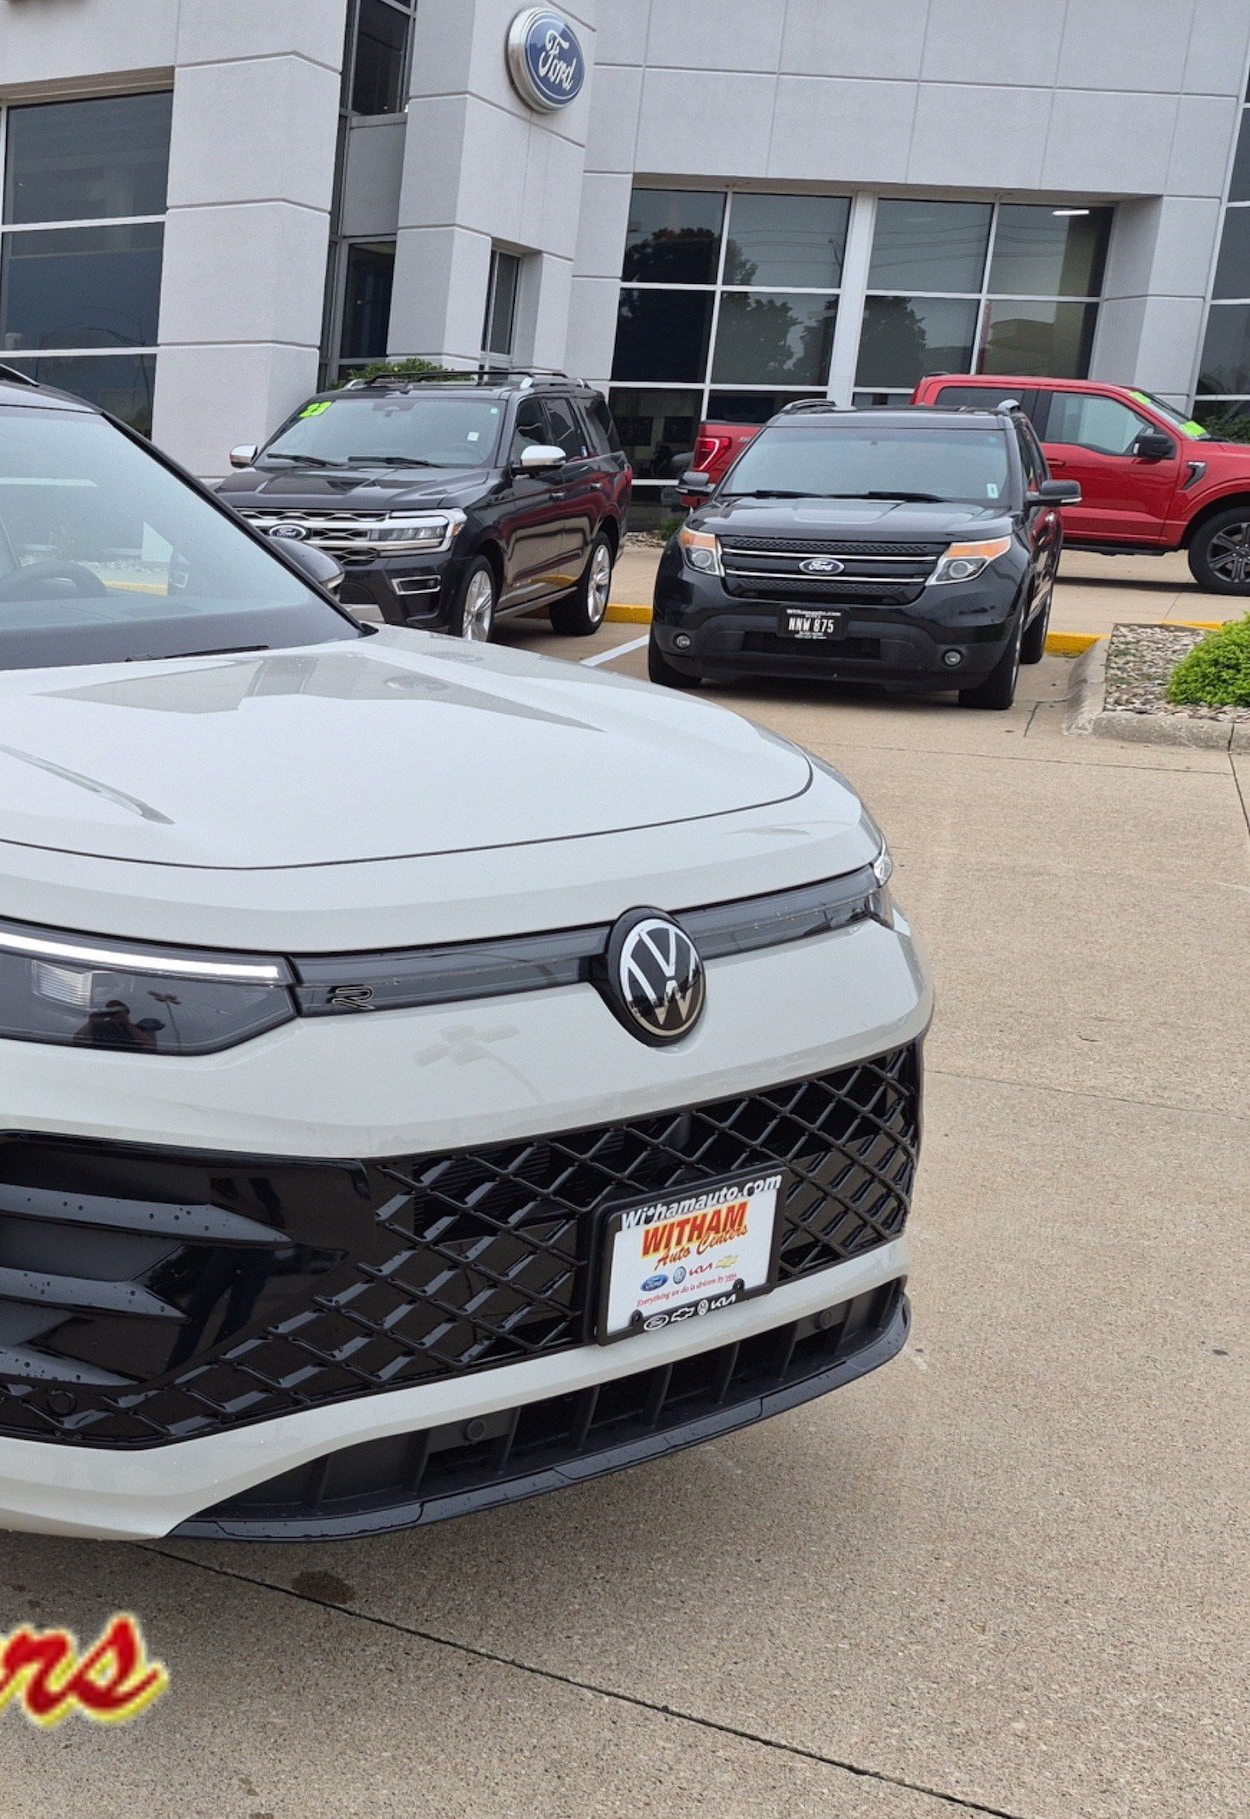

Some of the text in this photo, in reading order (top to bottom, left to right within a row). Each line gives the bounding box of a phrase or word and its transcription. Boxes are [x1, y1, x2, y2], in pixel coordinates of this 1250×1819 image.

[538, 29, 576, 91] Ford
[808, 560, 834, 571] Ford
[813, 619, 835, 633] 875
[642, 1201, 748, 1256] WITHAM
[654, 1245, 690, 1271] Auto
